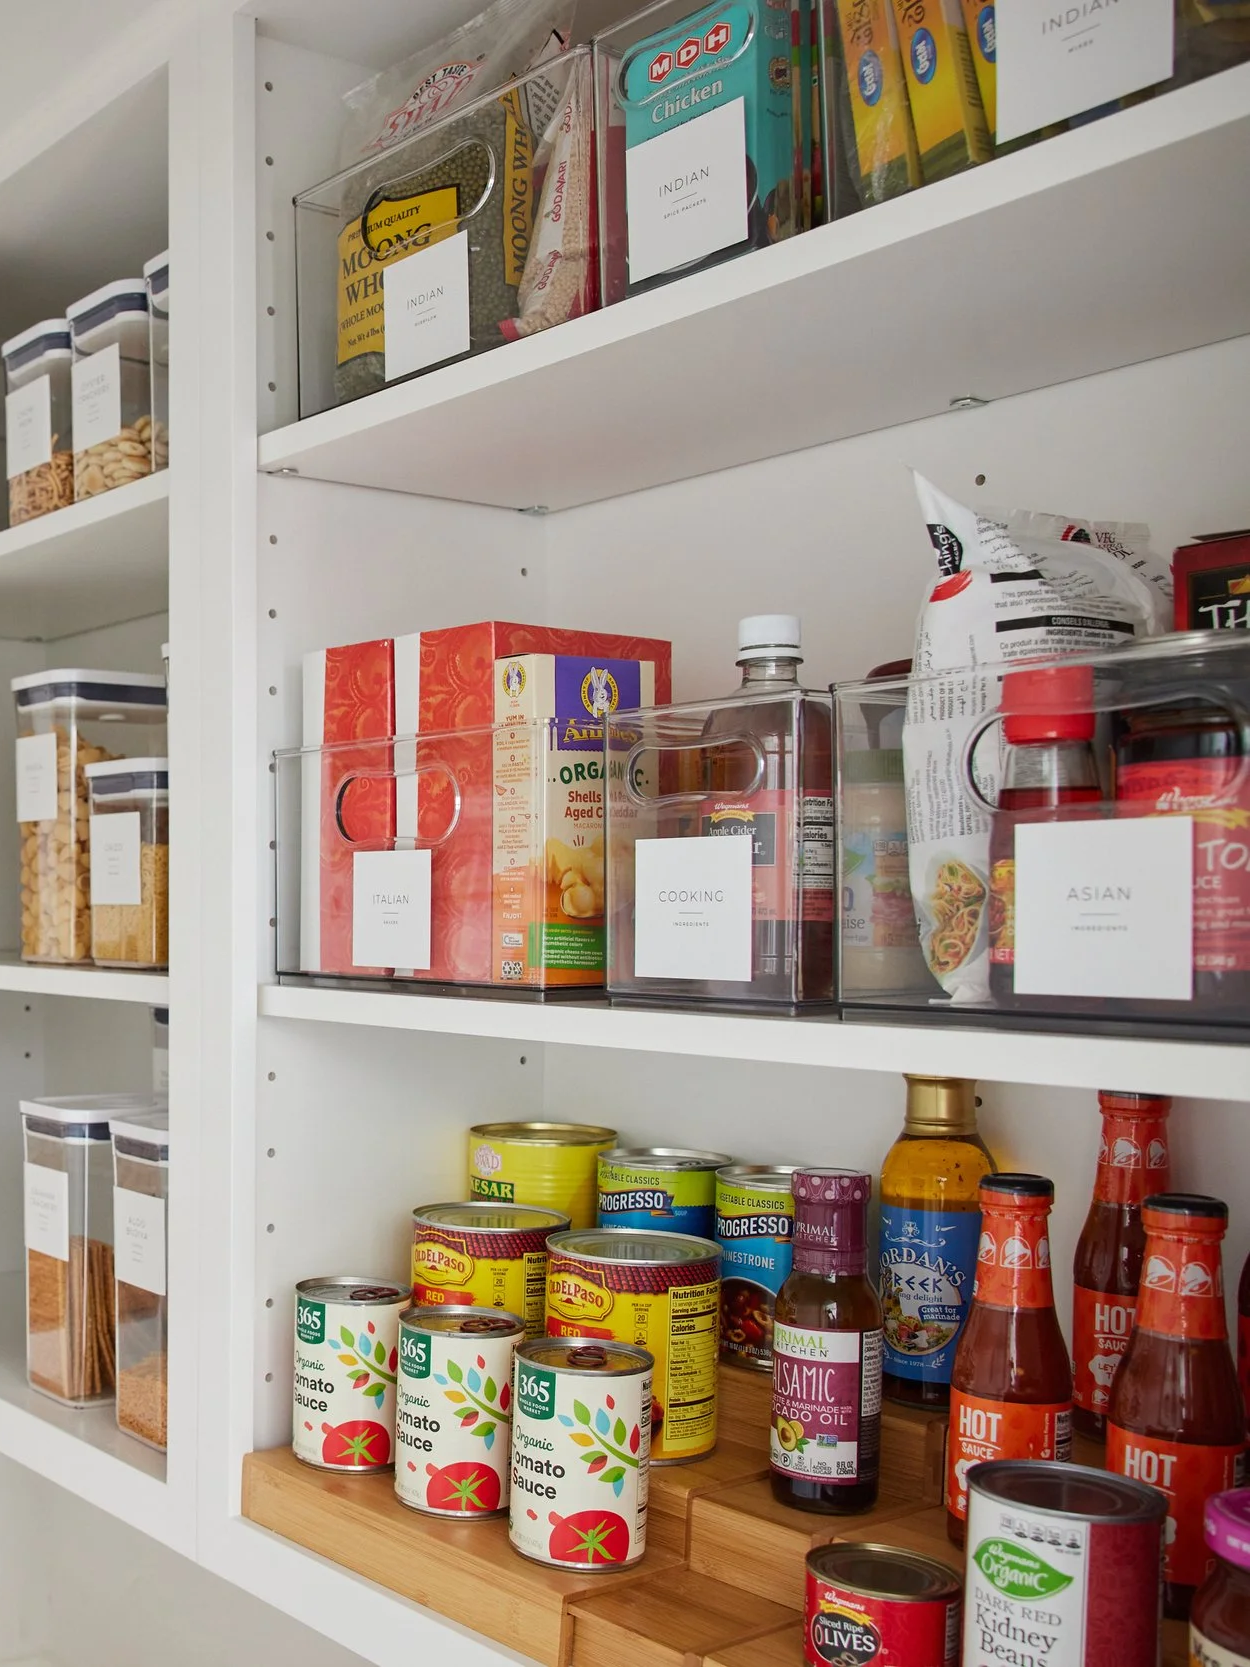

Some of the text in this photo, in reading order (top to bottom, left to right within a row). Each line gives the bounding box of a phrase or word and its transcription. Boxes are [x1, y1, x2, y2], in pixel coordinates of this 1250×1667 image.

[651, 27, 728, 78] MDH
[651, 79, 724, 124] Chicken
[551, 160, 568, 223] GODAVARI
[658, 166, 710, 198] INDIAN
[383, 205, 421, 226] QUALITY
[510, 178, 529, 274] MOONG
[406, 286, 445, 311] INDIAN
[1051, 616, 1082, 627] CONSEILS
[568, 790, 602, 803] Shells
[564, 806, 593, 821] Aged
[714, 802, 749, 811] Wegmans
[730, 825, 757, 836] Cider
[372, 894, 410, 905] ITALIAN
[658, 889, 724, 904] COOKING
[1065, 886, 1132, 902] ASIAN
[625, 1174, 660, 1186] CLASSICS
[599, 1191, 664, 1211] PROGRESSO
[746, 1197, 785, 1210] CLASSICS
[717, 1216, 789, 1238] PROGRESSO
[796, 1221, 836, 1237] PRIMAL
[880, 1247, 967, 1287] ORDAN'S
[425, 1290, 445, 1303] RED
[672, 1287, 706, 1300] Nutrition
[913, 1292, 943, 1304] delight
[297, 1306, 321, 1329] 365
[671, 1307, 689, 1315] Serving
[921, 1306, 956, 1314] Great for
[923, 1312, 961, 1321] marinade
[560, 1325, 581, 1337] RED
[671, 1323, 696, 1333] Calories
[775, 1328, 825, 1349] PRIMAL
[1098, 1338, 1127, 1351] SAUC
[401, 1337, 427, 1363] 365
[776, 1342, 828, 1358] KITCHEN
[295, 1370, 335, 1394] omato
[519, 1374, 550, 1403] 365
[398, 1384, 431, 1408] Organic
[523, 1405, 541, 1416] MARKET
[532, 1401, 549, 1412] FOODS
[791, 1401, 840, 1414] MARINADE
[398, 1407, 441, 1433] omato
[819, 1413, 848, 1426] OIL
[959, 1404, 1003, 1443] HOT
[515, 1424, 554, 1452] Organic
[961, 1441, 995, 1460] SAUCE
[1124, 1444, 1177, 1487] HOT
[512, 1466, 557, 1500] Sauce
[989, 1543, 1041, 1570] Wegmans
[824, 1590, 866, 1612] Wegmans
[975, 1586, 1063, 1627] DARK RED
[818, 1615, 865, 1634] Sliced Ripe
[976, 1602, 1059, 1655] Kidney
[814, 1623, 876, 1653] OLIVES
[979, 1628, 1048, 1667] Beans
